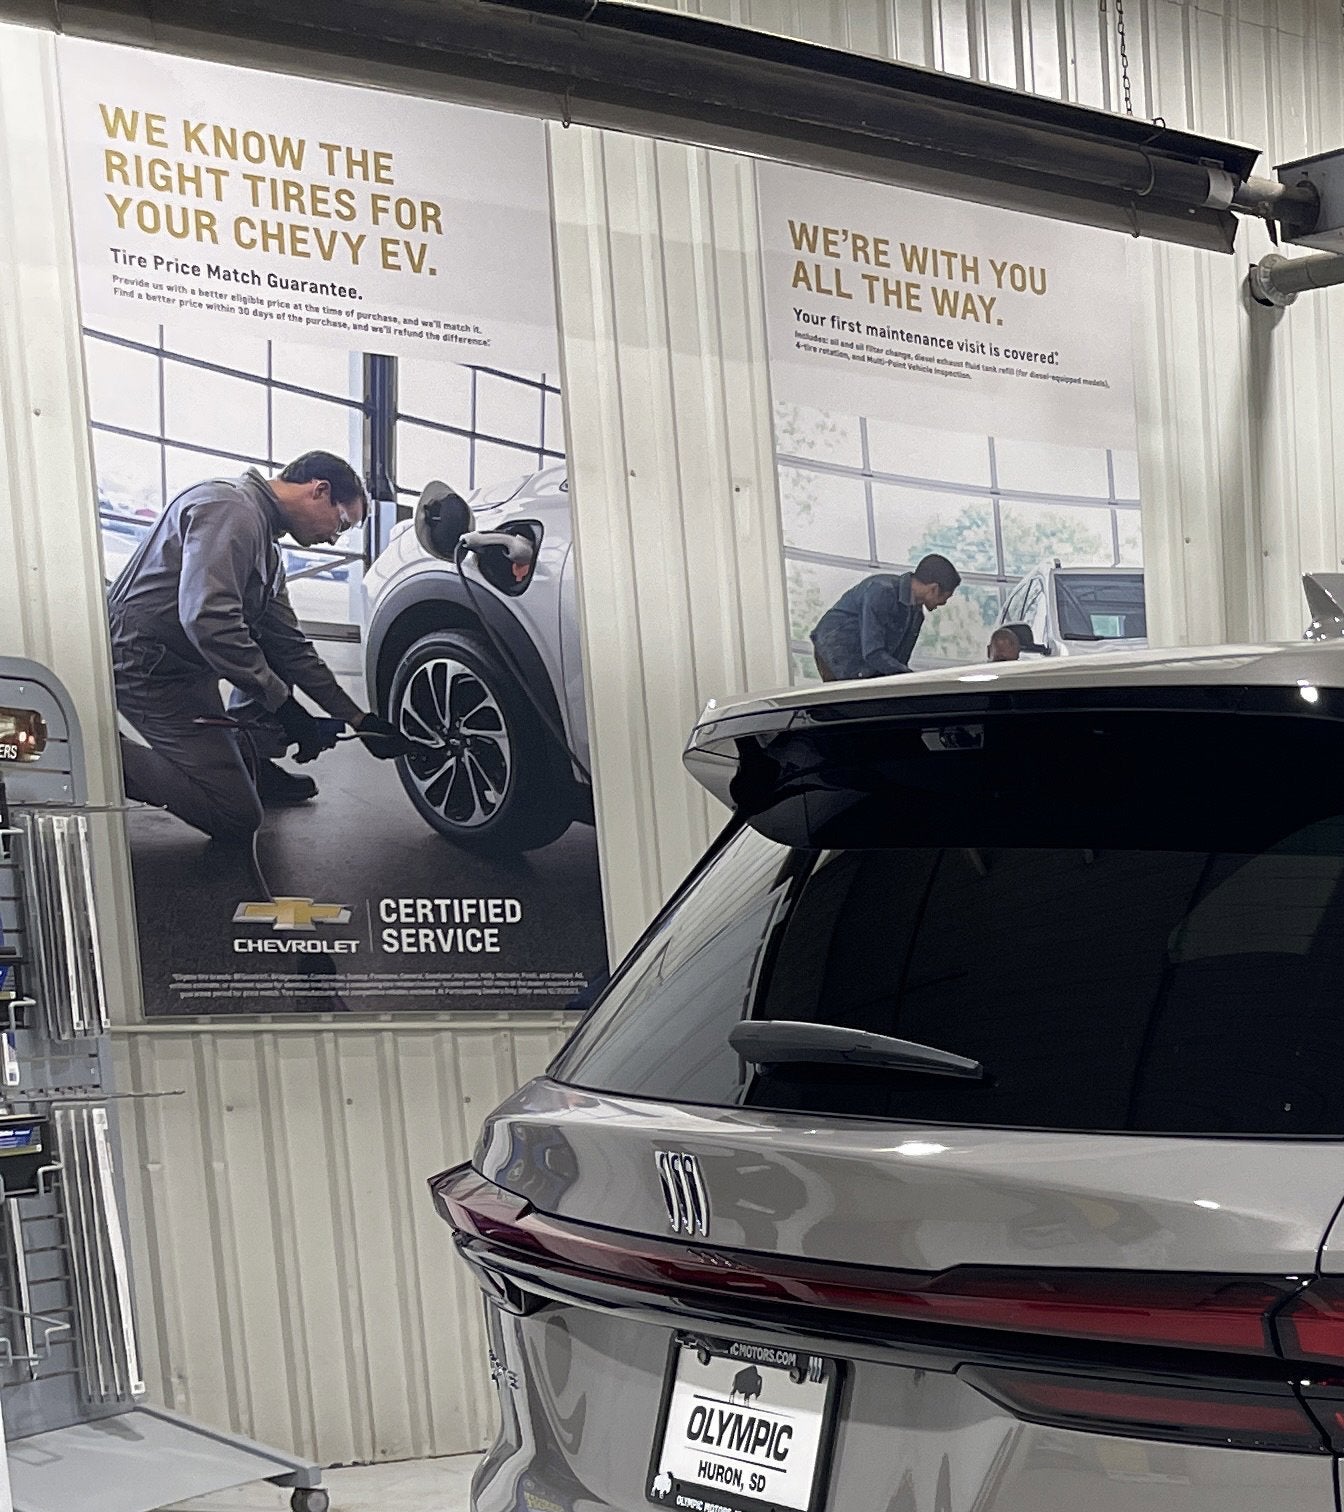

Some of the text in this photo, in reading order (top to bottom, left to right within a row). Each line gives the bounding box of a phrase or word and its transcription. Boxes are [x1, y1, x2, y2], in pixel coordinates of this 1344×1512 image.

[100, 104, 394, 184] WE KNOW THE
[104, 150, 444, 234] RIGHT TIRES FOR
[106, 195, 437, 275] YOUR CHEVY EV.
[787, 221, 1047, 295] WE'RE WITH YOU
[112, 248, 362, 299] Tire Price Match Guarantee.
[792, 261, 1002, 325] ALL THE WAY.
[792, 307, 827, 326] Your
[829, 314, 862, 333] first
[865, 325, 954, 348] maintenance
[956, 338, 986, 354] visit
[988, 342, 1000, 356] is
[379, 897, 523, 926] CERTIFIED
[232, 937, 360, 955] CHEVROLET
[381, 927, 501, 955] SERVICE
[686, 1405, 794, 1462] OLYMPIC
[697, 1459, 767, 1493] HURON, SD
[676, 1495, 704, 1511] OLYMPIC
